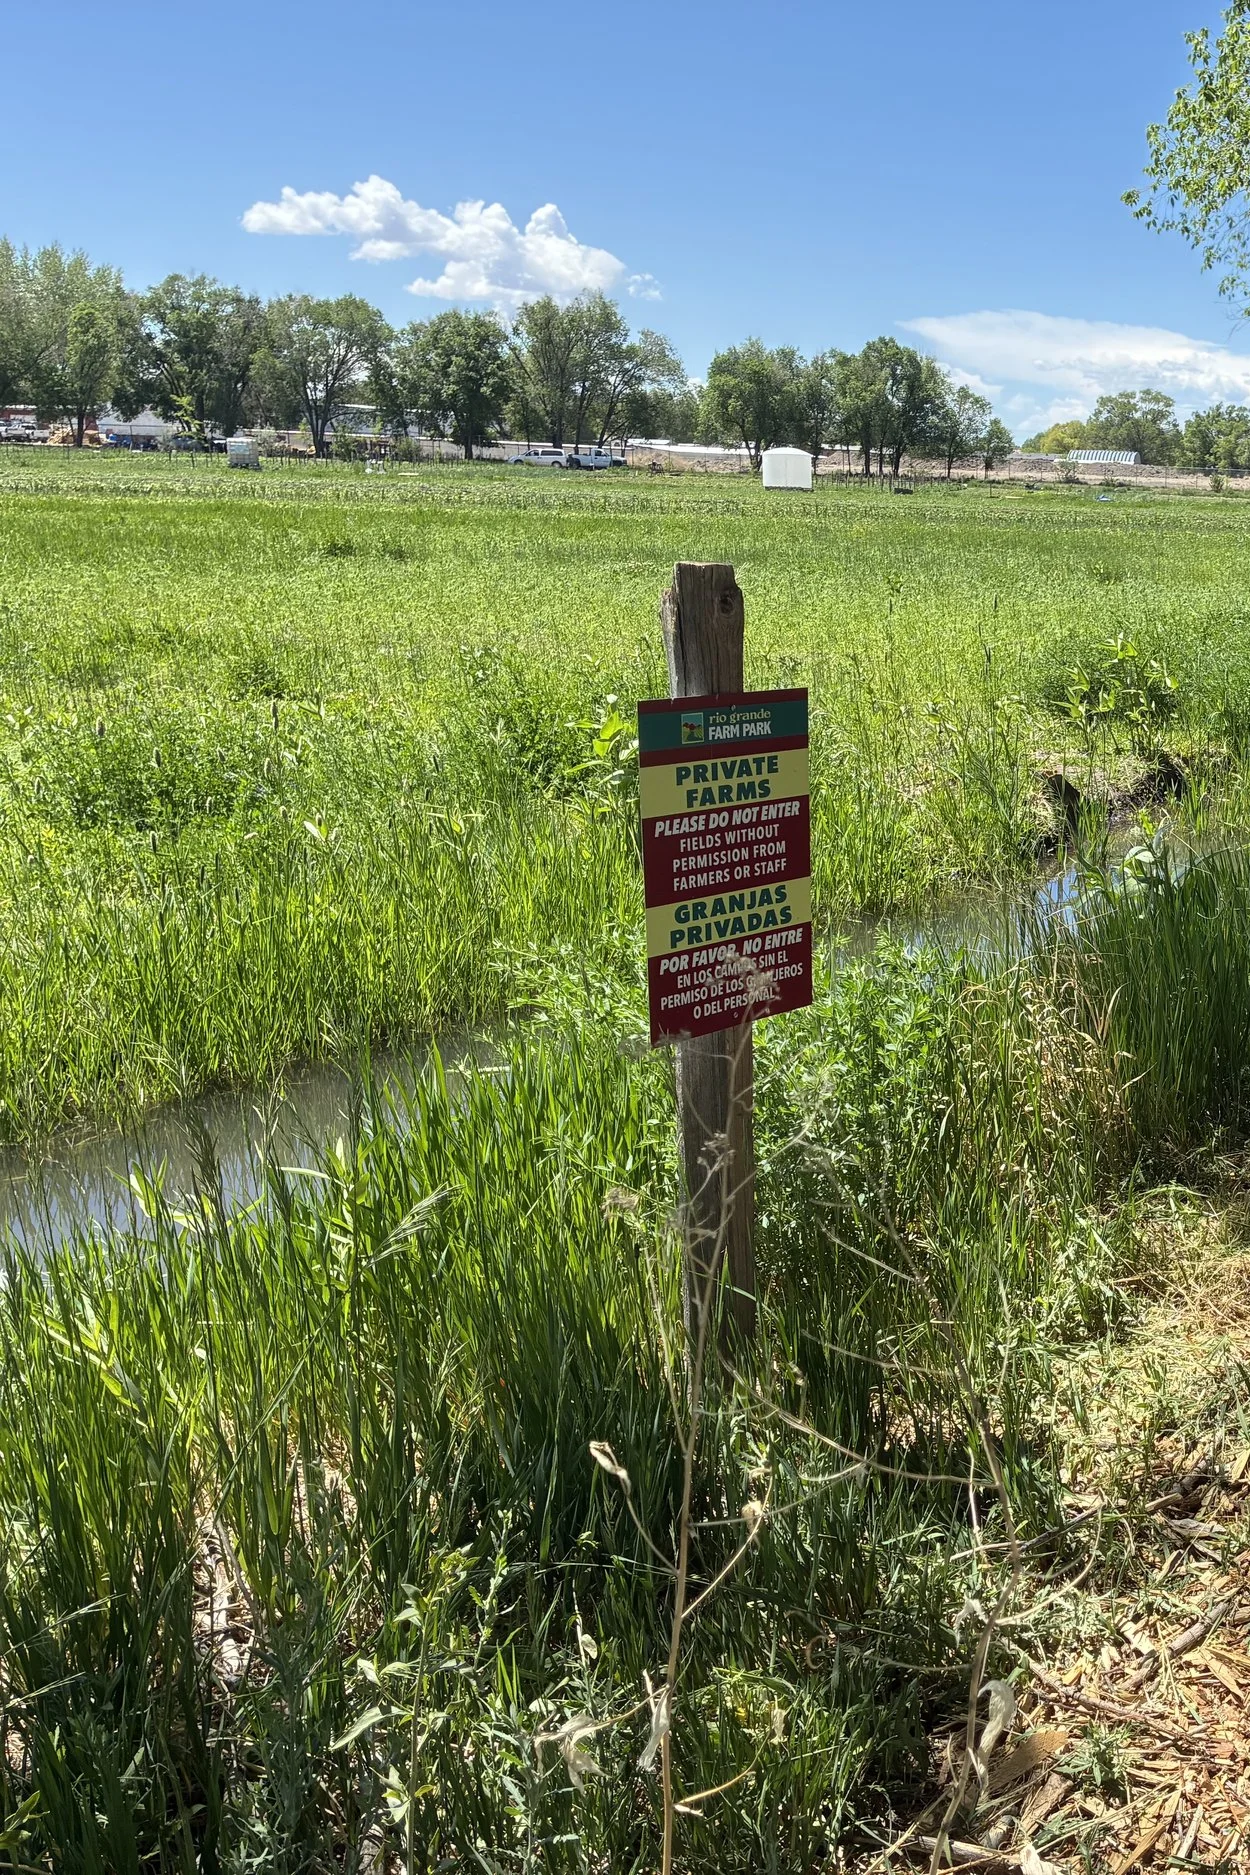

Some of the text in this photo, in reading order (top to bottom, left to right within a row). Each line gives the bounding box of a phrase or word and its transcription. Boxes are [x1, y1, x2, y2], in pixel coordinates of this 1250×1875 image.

[708, 721, 771, 740] FARM PARK
[709, 709, 771, 724] rio grande
[676, 756, 778, 785] PRIVATE
[686, 779, 770, 808] FARMS
[655, 801, 800, 837] PLEASE DO NOT ENTER
[680, 824, 779, 852] FIELDS WITHOUT
[673, 841, 786, 872] PERMISSION FROM
[673, 859, 787, 891] FARMERS OR STAFF
[674, 885, 787, 923] GRANJAS
[670, 906, 792, 949] PRIVADAS
[660, 956, 689, 975] POR
[743, 937, 761, 955] NO
[765, 928, 803, 949] ENTRE
[677, 974, 691, 988] EN
[694, 970, 712, 984] LOS
[759, 955, 775, 968] SIN
[777, 950, 788, 963] EL
[660, 963, 803, 1010] PERMISO DE LOS GJEROS
[693, 987, 775, 1019] O DEL PERSONAL
